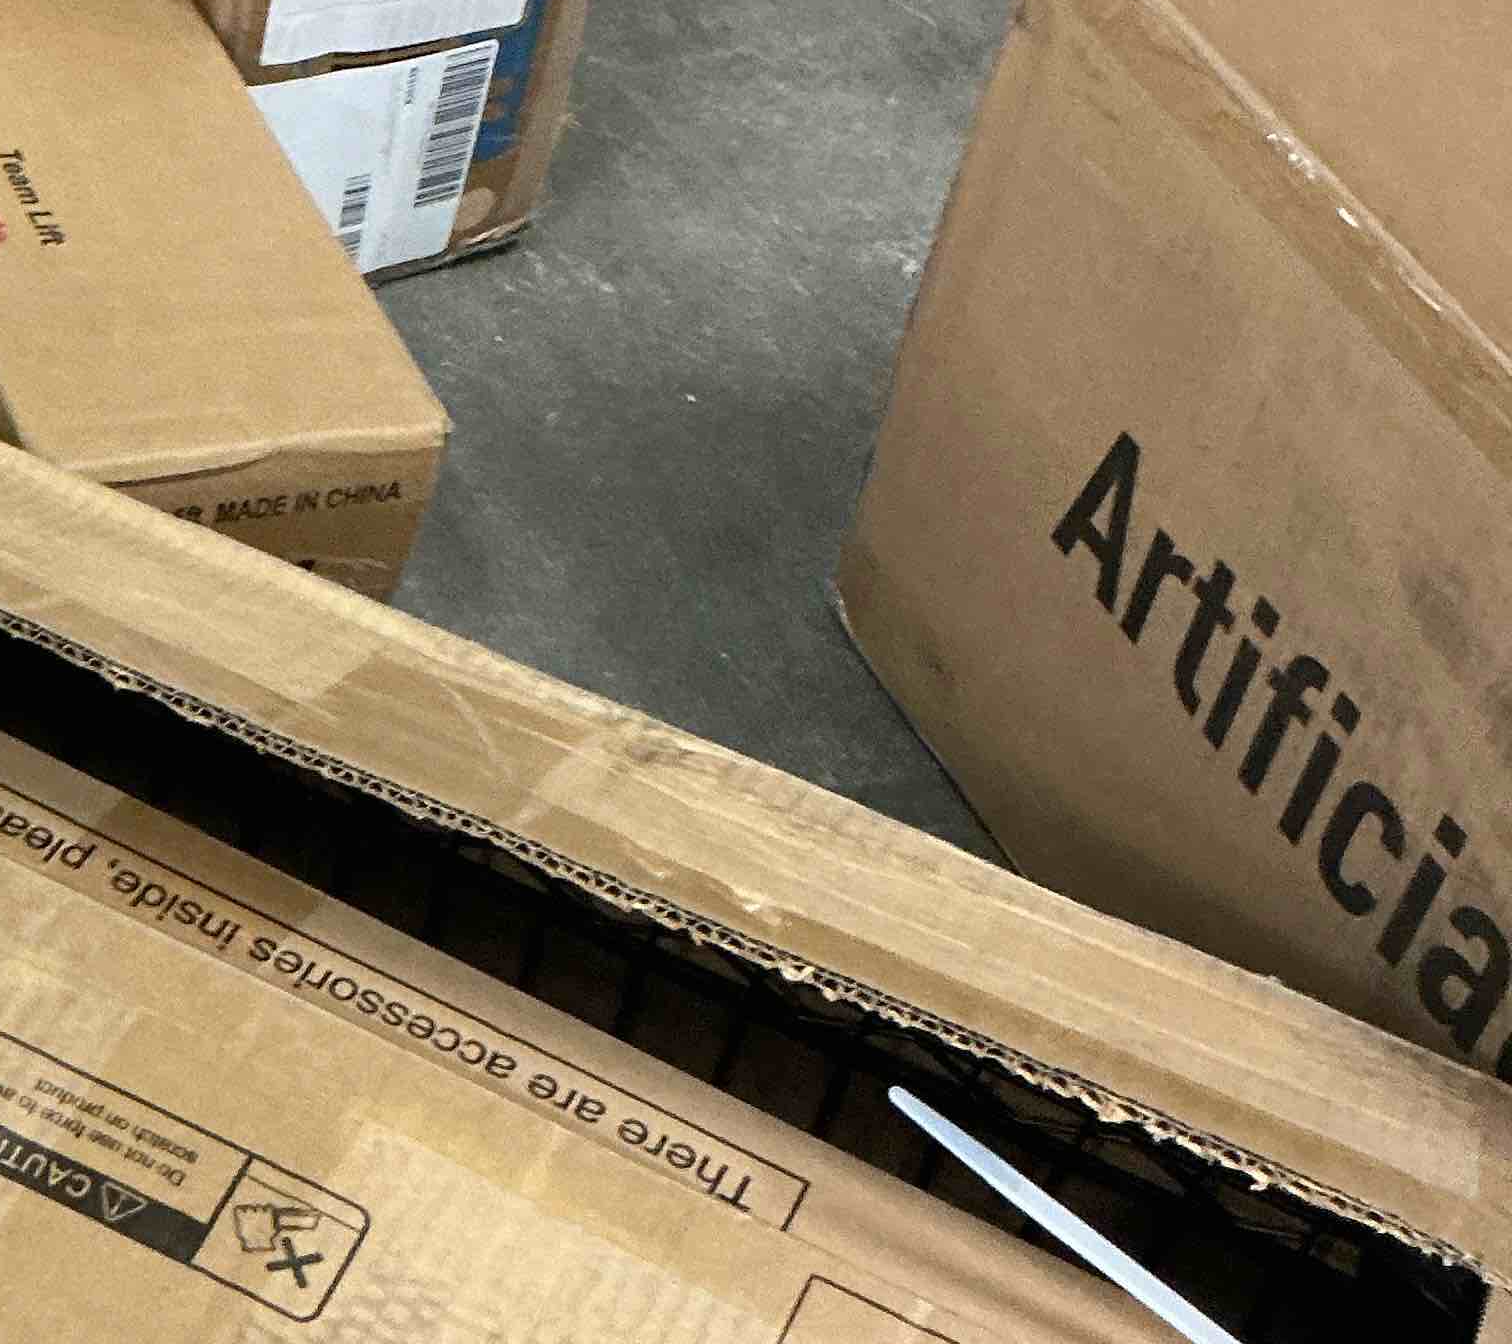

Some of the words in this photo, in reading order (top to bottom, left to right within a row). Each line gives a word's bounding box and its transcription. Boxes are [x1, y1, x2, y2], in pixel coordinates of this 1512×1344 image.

[24, 210, 66, 246] Lift
[215, 495, 288, 524] MADE
[294, 490, 320, 512] IN
[326, 480, 402, 509] CHINA
[1051, 431, 1512, 1076] Artificia
[105, 859, 240, 953] inside,
[248, 933, 518, 1080] accessories
[18, 1094, 41, 1116] to
[33, 1078, 106, 1118] product
[527, 1070, 608, 1125] are
[39, 1107, 87, 1140] force
[89, 1128, 123, 1153] use
[104, 1111, 131, 1132] on
[123, 1145, 157, 1169] not
[133, 1123, 200, 1164] scratch
[157, 1162, 189, 1187] Do
[617, 1116, 755, 1214] There
